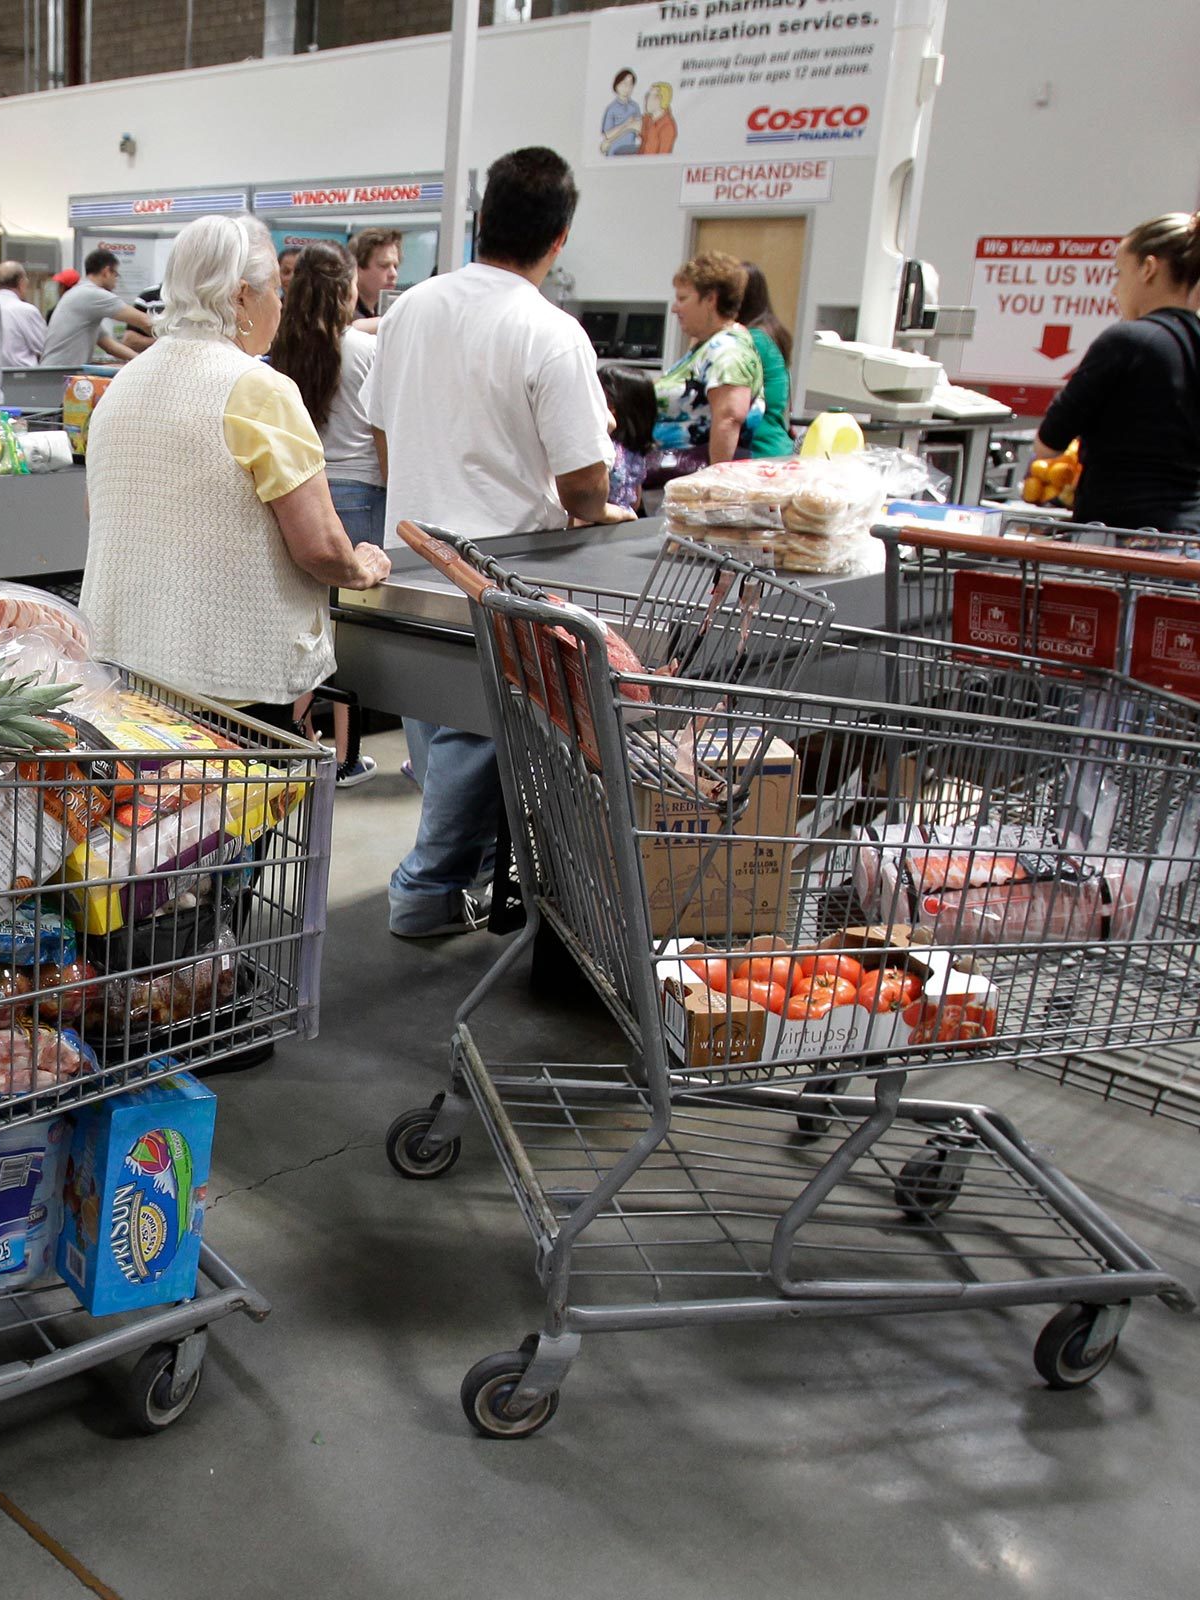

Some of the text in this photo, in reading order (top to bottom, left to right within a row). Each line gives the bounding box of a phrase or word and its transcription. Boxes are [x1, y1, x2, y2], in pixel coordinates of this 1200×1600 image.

[658, 0, 807, 21] This pharmacy
[637, 10, 880, 49] immunization services.
[682, 43, 876, 71] Whooping Cough and other vaccines
[680, 61, 872, 88] are available for ages 12 and above.
[747, 104, 870, 132] COSTCO
[796, 128, 865, 141] PHARMACY
[686, 160, 827, 184] MERCHANDISE
[291, 183, 422, 205] WINDOW FASHIONS
[714, 182, 793, 201] PICK-UP
[133, 199, 174, 214] CARPET
[983, 240, 1008, 255] We
[1011, 239, 1054, 256] Value
[1058, 239, 1097, 256] Your
[984, 264, 1120, 286] TELL US WH
[998, 293, 1120, 317] YOU THINK
[970, 629, 1017, 646] COSTCO
[654, 818, 738, 847] MIL
[778, 1026, 859, 1047] virtuoso
[141, 1211, 157, 1256] LESS SUGAR
